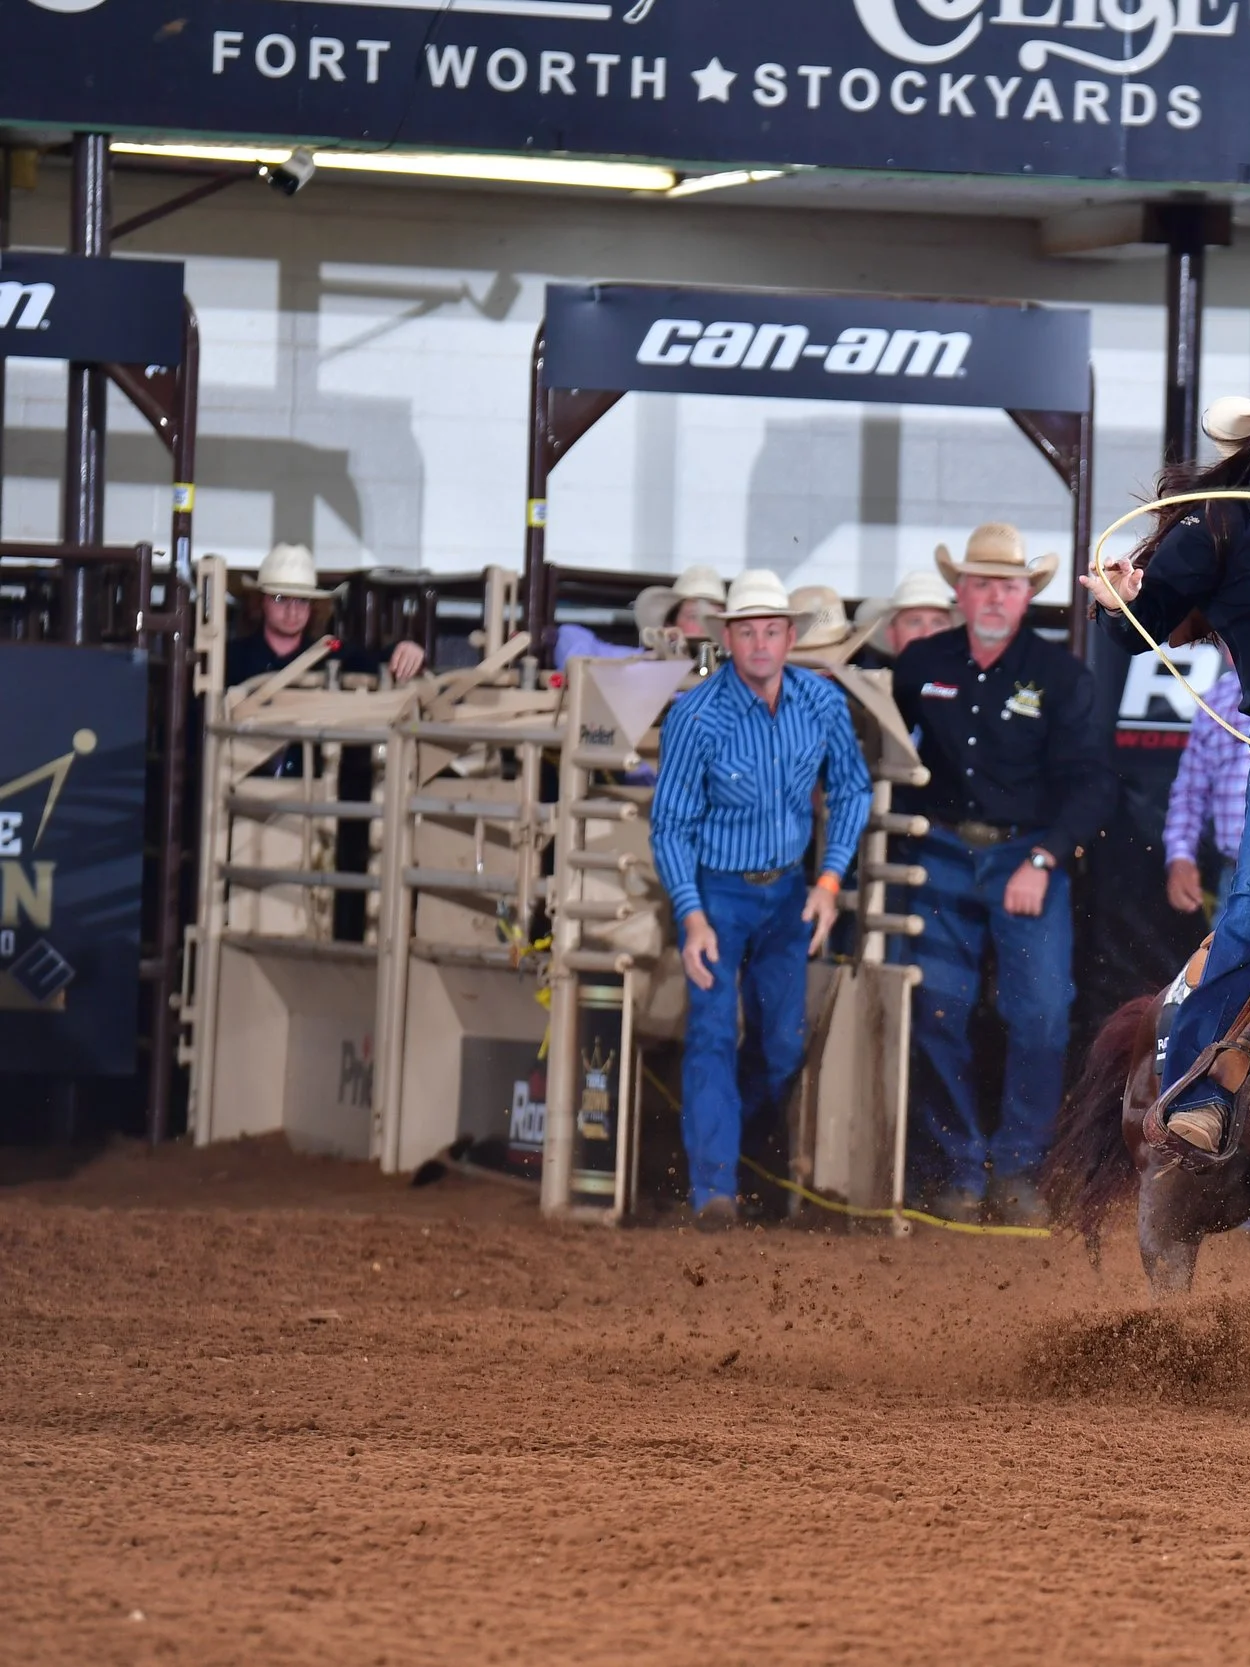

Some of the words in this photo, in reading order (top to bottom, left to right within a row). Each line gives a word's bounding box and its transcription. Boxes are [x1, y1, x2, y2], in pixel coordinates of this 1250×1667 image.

[211, 30, 391, 84] FORT
[425, 44, 667, 100] WORTH
[752, 62, 1202, 129] STOCKYARDS
[636, 318, 972, 378] can-am
